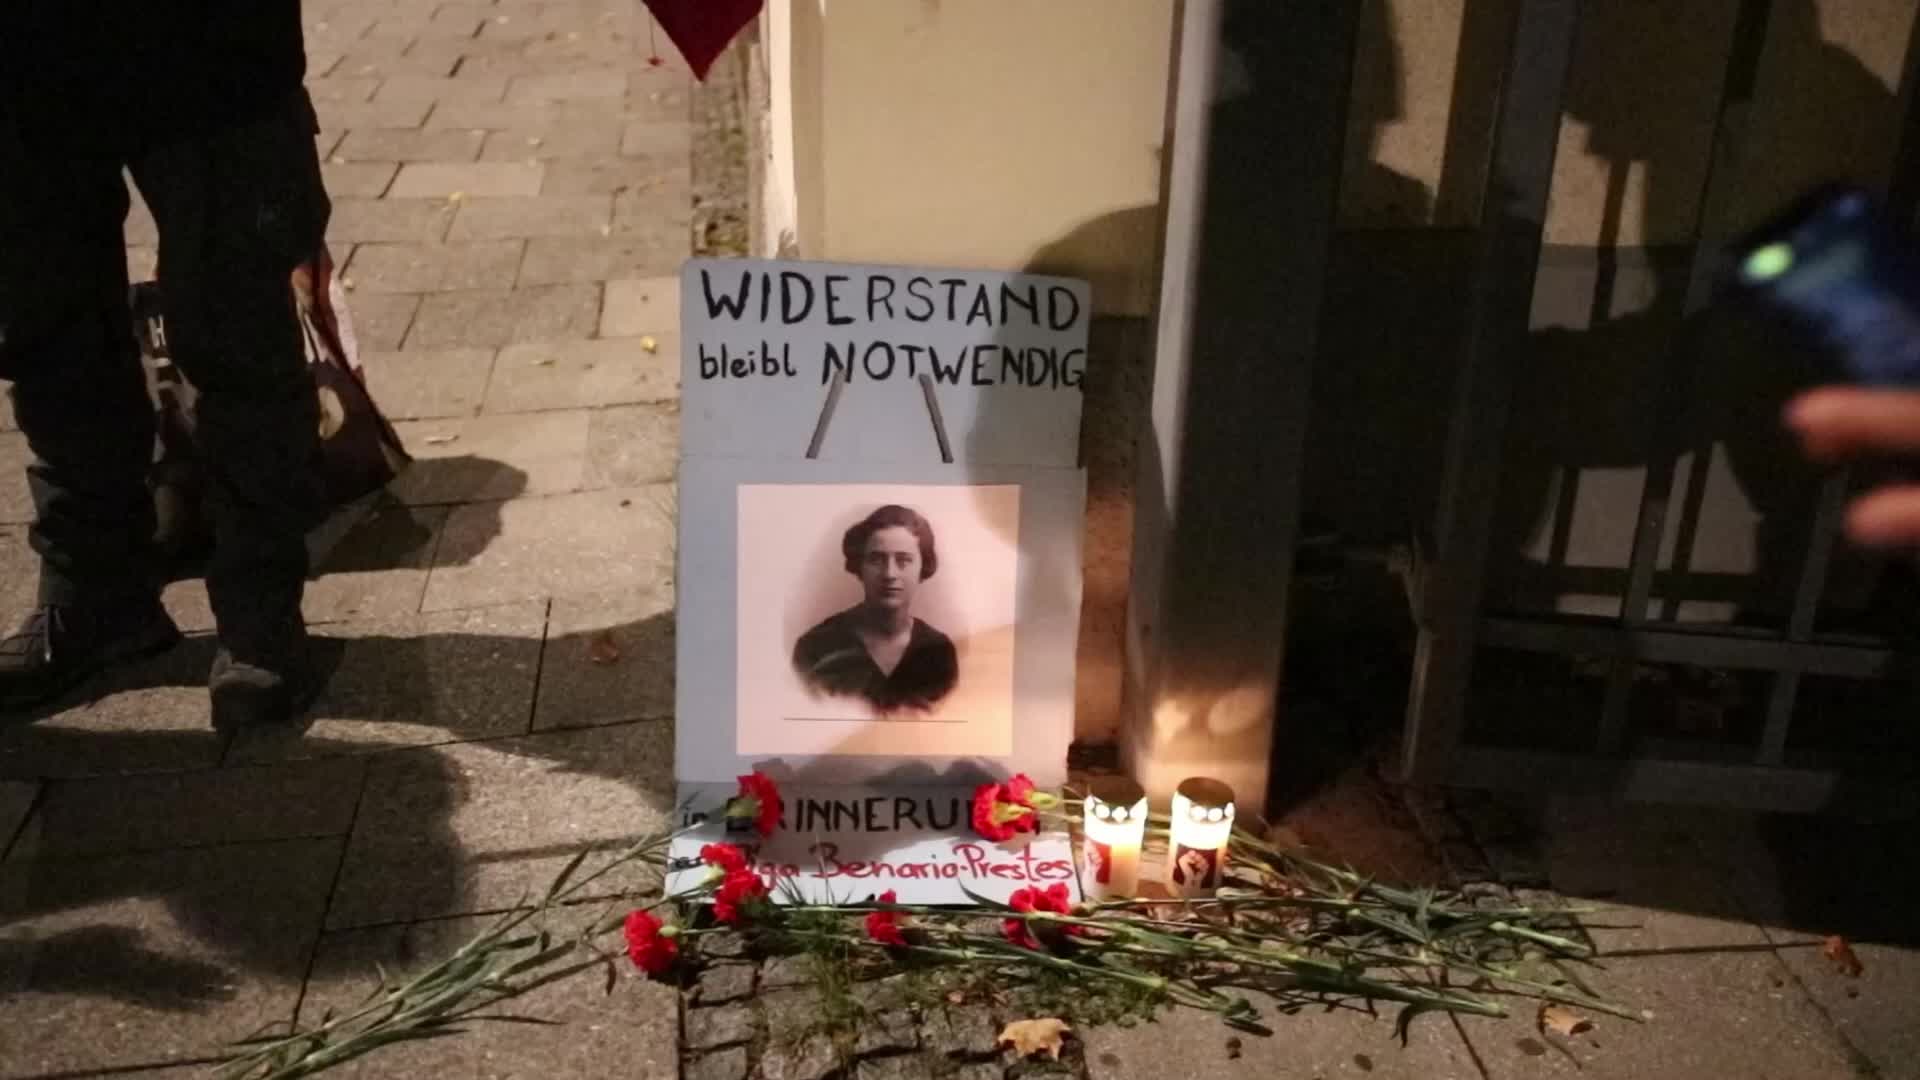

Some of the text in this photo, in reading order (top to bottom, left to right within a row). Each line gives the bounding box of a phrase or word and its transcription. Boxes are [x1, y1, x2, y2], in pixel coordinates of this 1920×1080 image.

[701, 269, 1080, 332] WIDERSTAND
[821, 340, 1086, 391] NOTWENDIG
[809, 841, 1074, 882] Benario-Prestes
